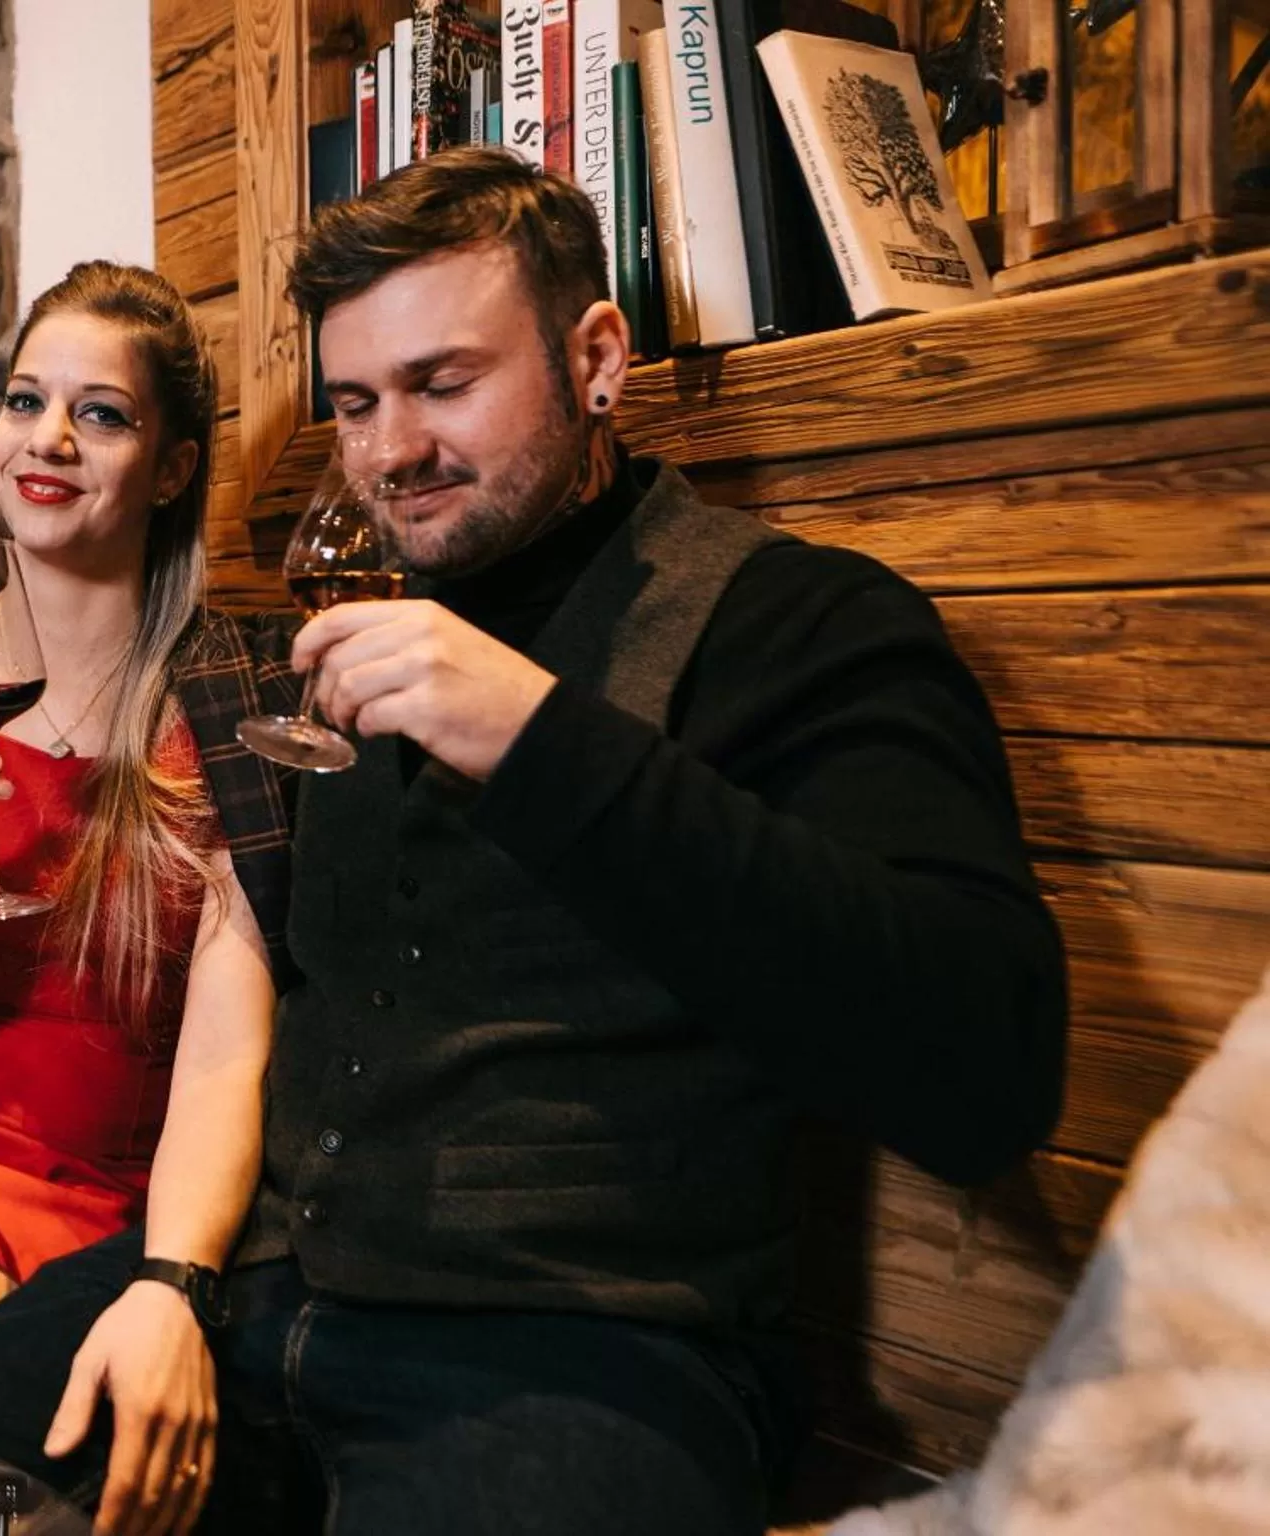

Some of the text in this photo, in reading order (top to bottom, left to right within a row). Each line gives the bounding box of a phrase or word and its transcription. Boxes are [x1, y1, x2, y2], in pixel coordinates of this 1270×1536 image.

[413, 16, 433, 111] ÖSTERREICH
[504, 4, 541, 103] Zucht
[585, 31, 609, 122] UNTER
[676, 5, 714, 124] Kaprun
[585, 125, 609, 184] DEN
